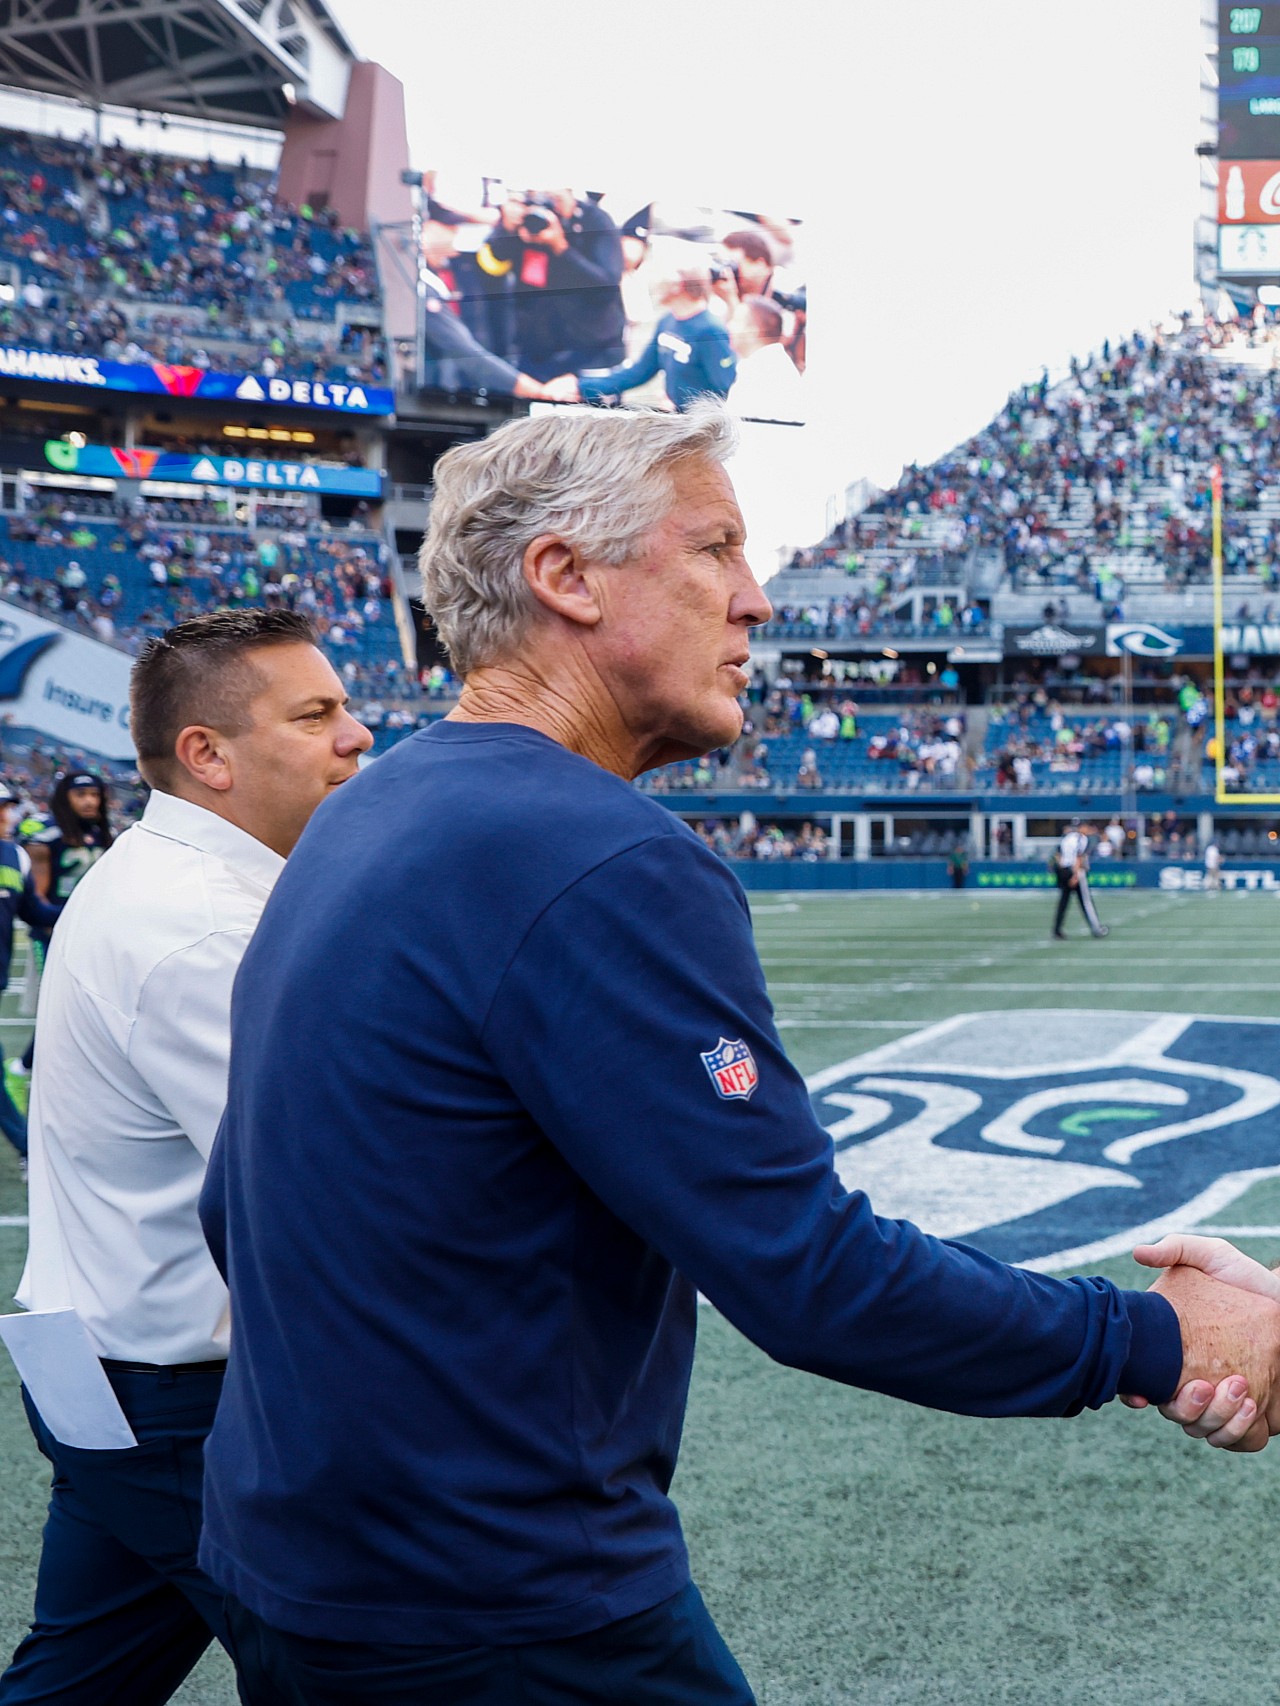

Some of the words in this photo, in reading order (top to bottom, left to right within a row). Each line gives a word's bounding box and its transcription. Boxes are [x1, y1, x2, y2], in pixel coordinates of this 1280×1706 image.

[269, 377, 369, 409] DELTA
[222, 459, 321, 488] DELTA
[42, 677, 114, 723] Insure
[716, 1061, 757, 1093] NFL
